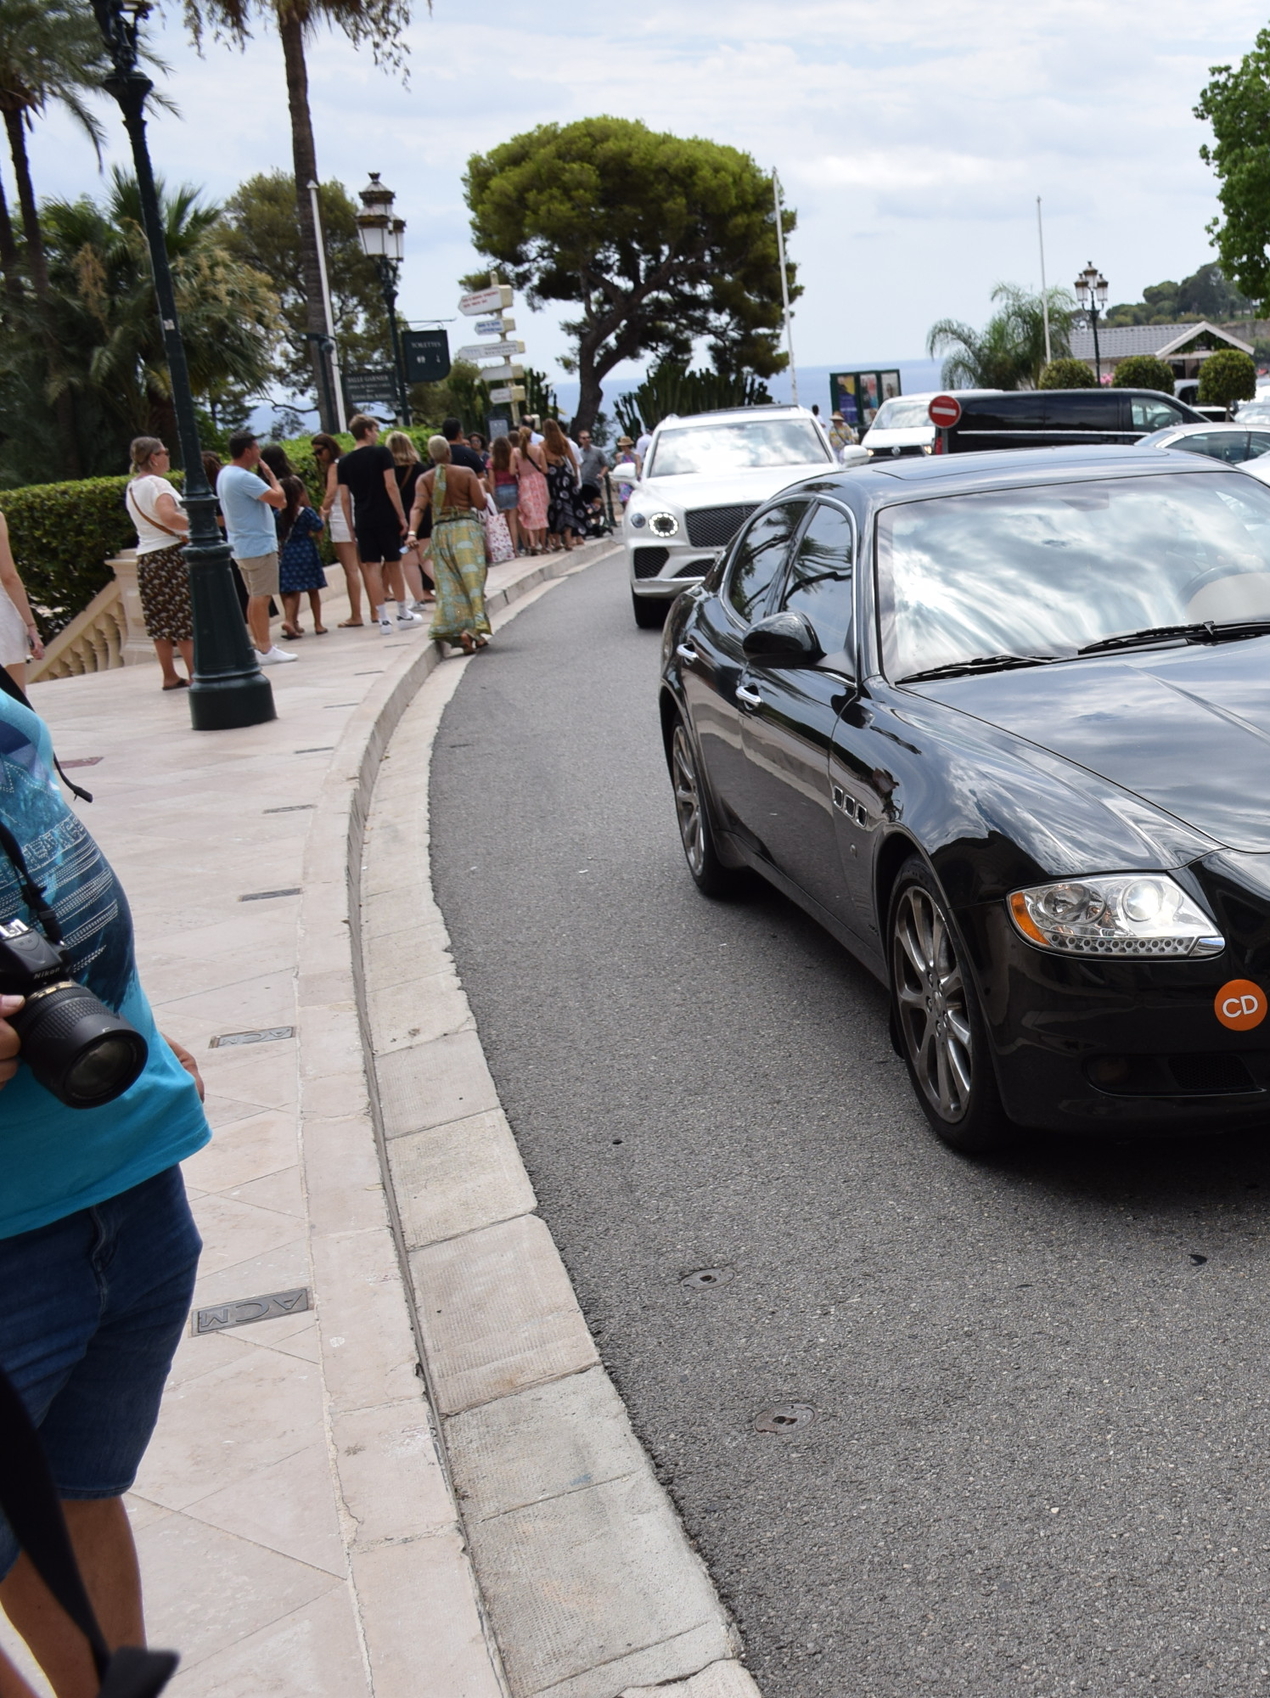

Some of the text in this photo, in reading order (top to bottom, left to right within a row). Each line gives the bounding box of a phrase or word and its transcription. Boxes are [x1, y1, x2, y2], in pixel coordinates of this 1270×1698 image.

[33, 966, 61, 980] Nikon
[1222, 994, 1259, 1018] CD
[200, 1293, 304, 1328] ACM
